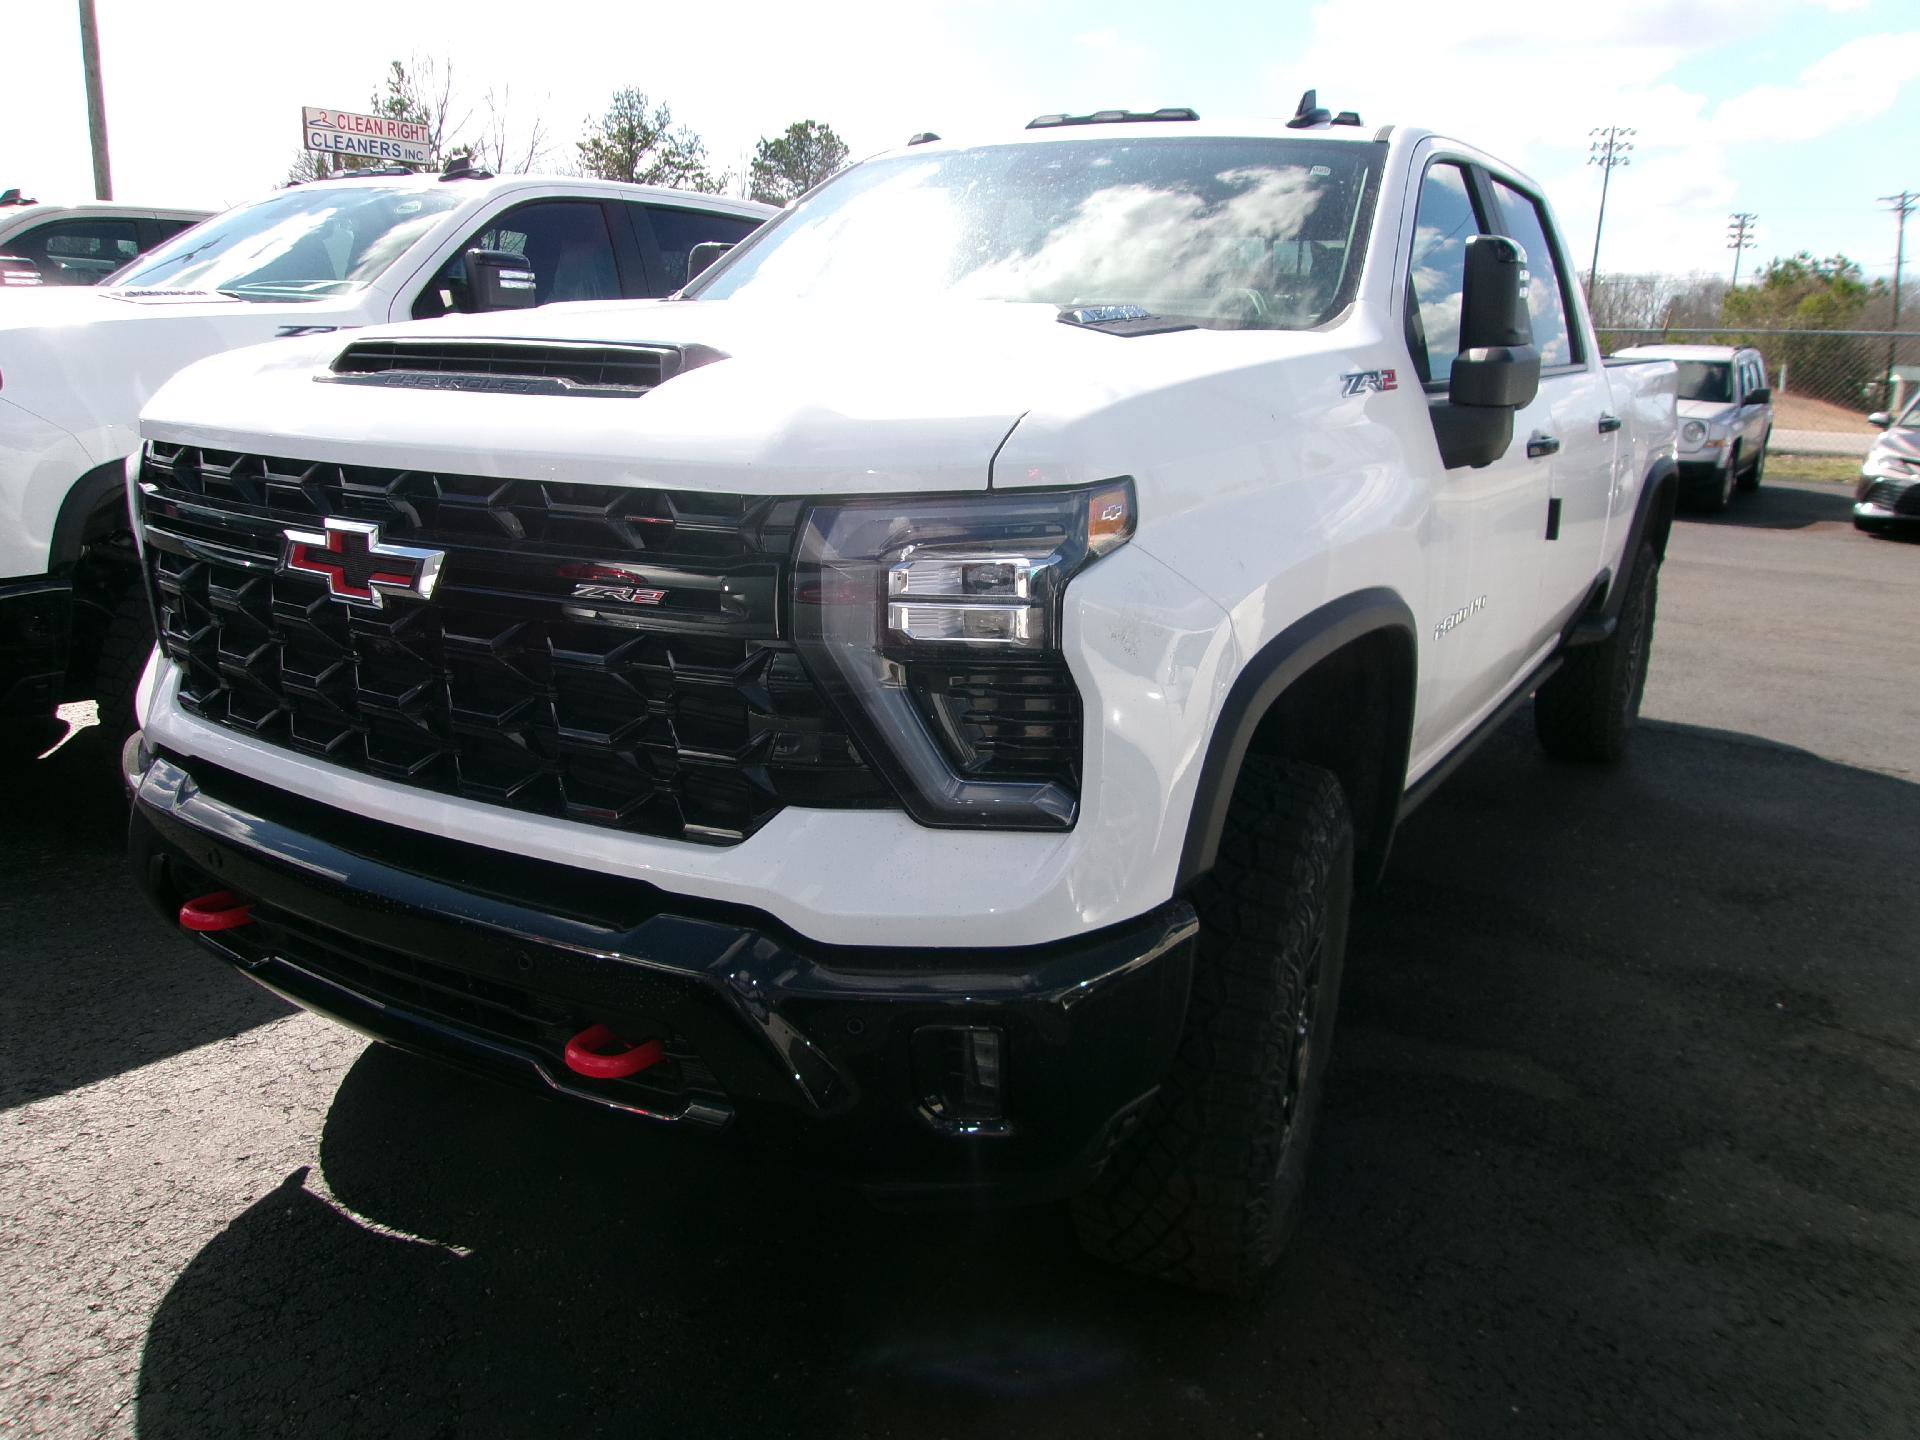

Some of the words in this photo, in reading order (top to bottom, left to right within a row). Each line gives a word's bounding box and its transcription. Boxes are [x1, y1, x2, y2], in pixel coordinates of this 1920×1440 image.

[337, 114, 383, 135] CLEAN
[387, 121, 427, 141] RIGHT
[311, 132, 402, 158] CLEANERS
[384, 374, 540, 392] CHEVROLET
[1340, 368, 1398, 398] ZR2
[570, 583, 670, 605] ZR2
